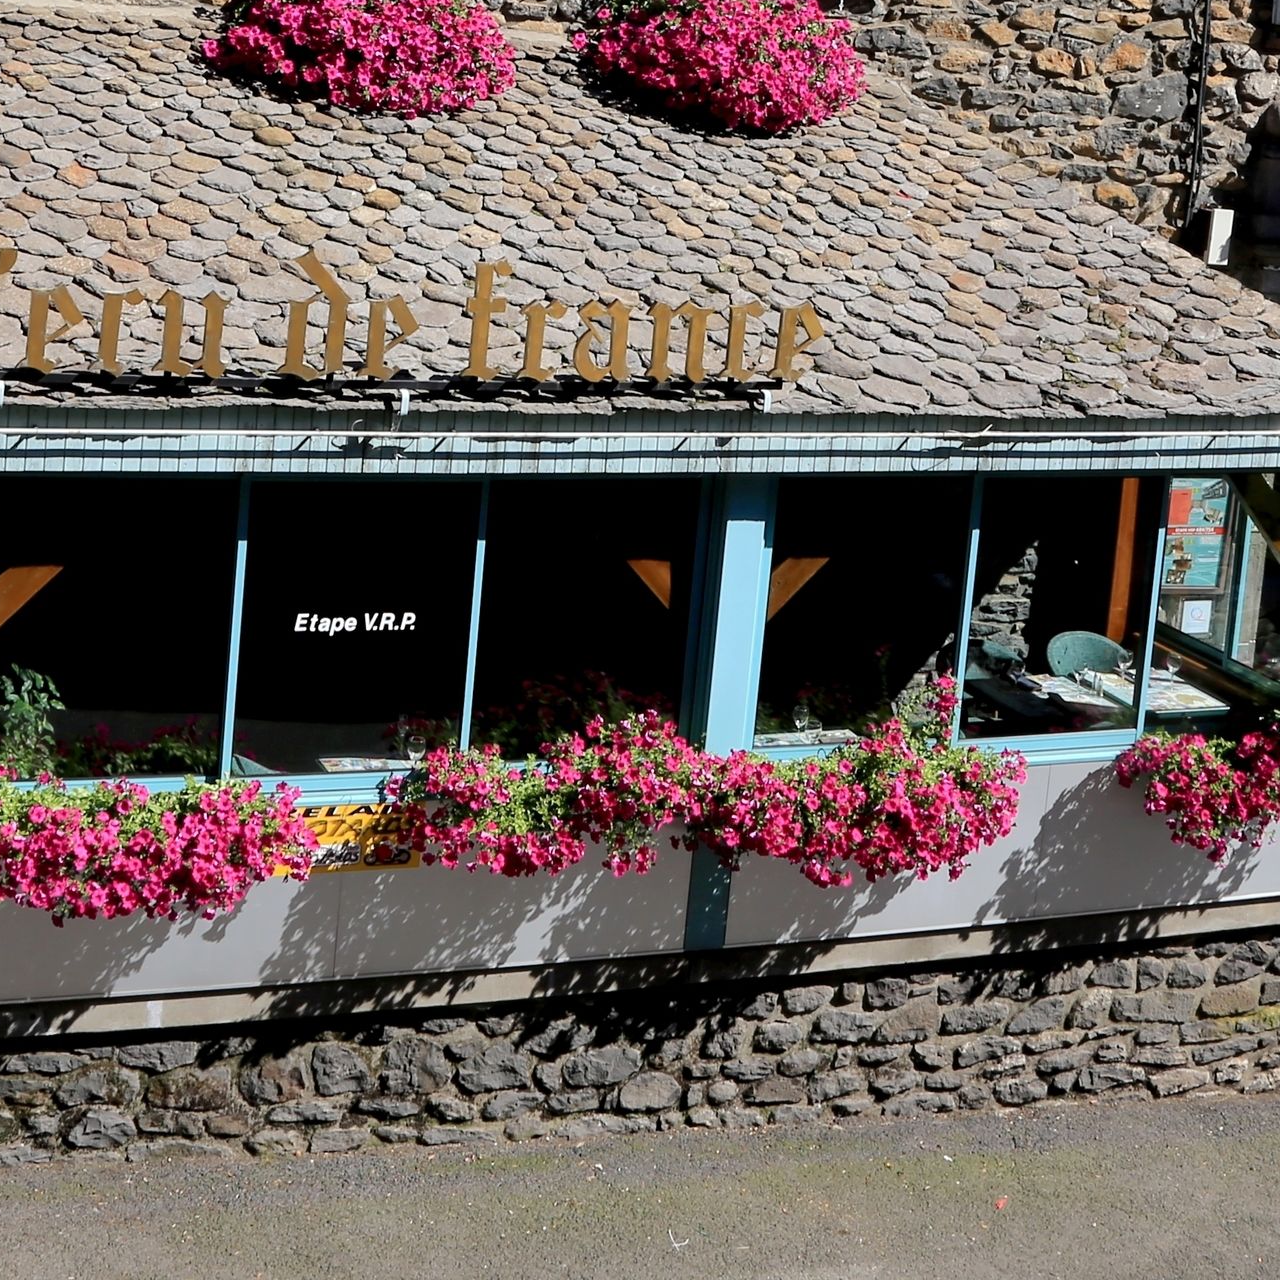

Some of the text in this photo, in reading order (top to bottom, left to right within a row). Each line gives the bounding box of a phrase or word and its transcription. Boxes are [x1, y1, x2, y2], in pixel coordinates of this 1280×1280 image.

[278, 248, 418, 382] de
[461, 259, 824, 383] france
[294, 612, 417, 637] Etape V.R.P.
